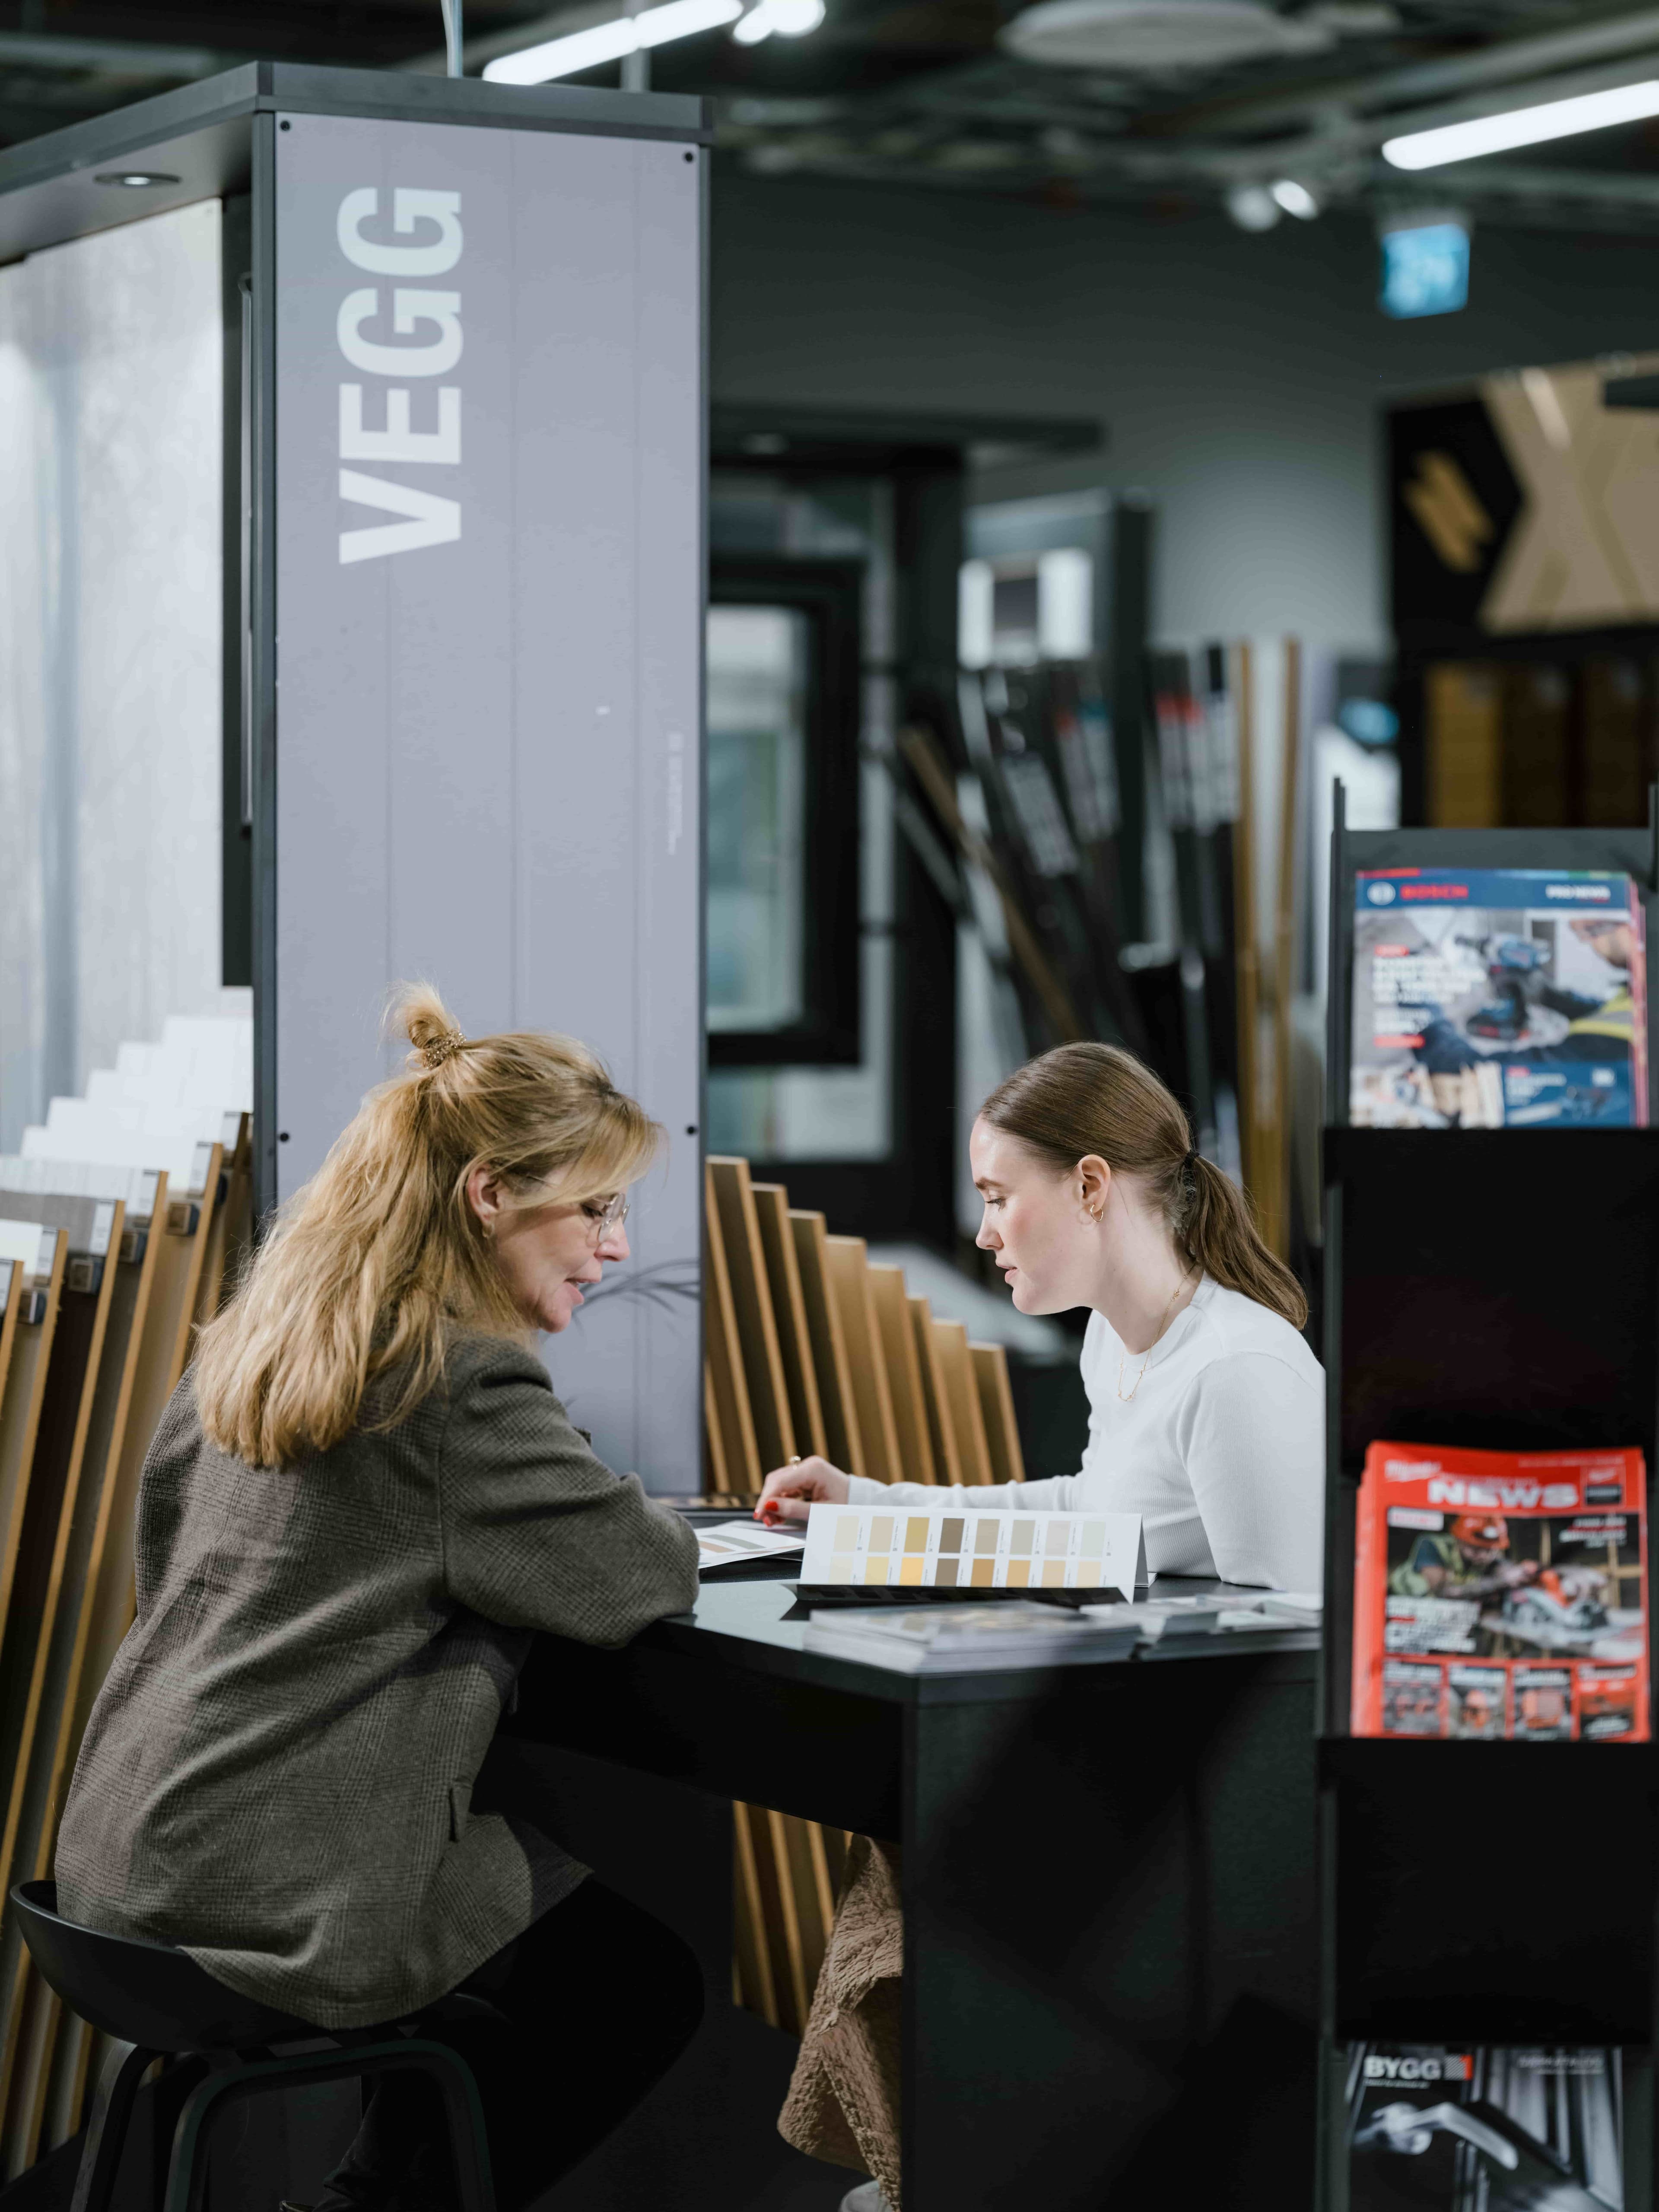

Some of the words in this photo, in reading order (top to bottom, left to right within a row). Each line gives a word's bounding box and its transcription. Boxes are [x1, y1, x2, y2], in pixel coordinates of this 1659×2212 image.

[337, 187, 464, 564] VEGG
[1427, 1479, 1578, 1508] NEWS
[1364, 2055, 1440, 2080] BYGG
